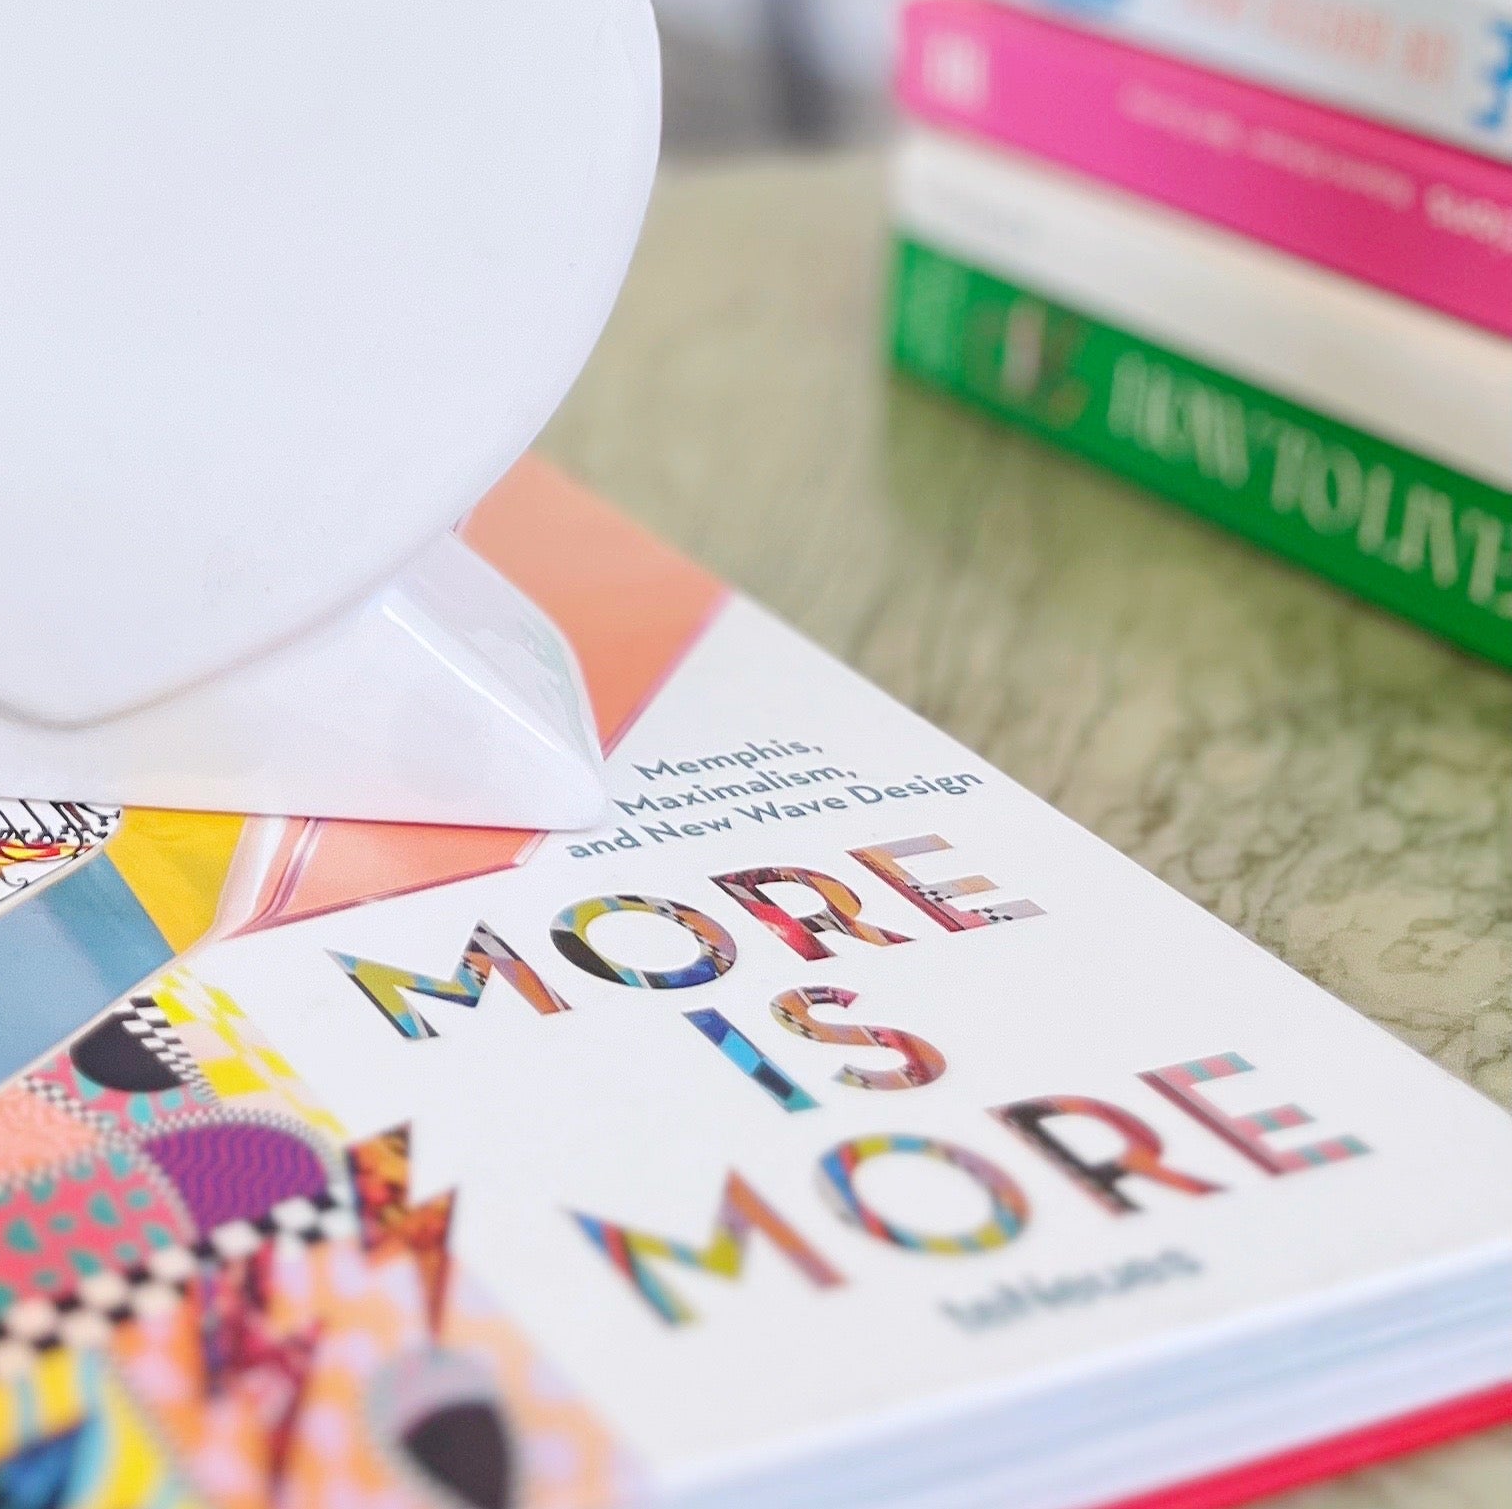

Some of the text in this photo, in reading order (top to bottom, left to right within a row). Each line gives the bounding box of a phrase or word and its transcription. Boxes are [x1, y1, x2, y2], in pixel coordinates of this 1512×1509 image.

[566, 769, 985, 859] and New Wave Design
[612, 764, 858, 817] Maximalism,
[631, 738, 824, 781] Memphis,
[323, 832, 1048, 1041] MORE
[681, 986, 948, 1114] IS
[560, 1048, 1376, 1328] MORE
